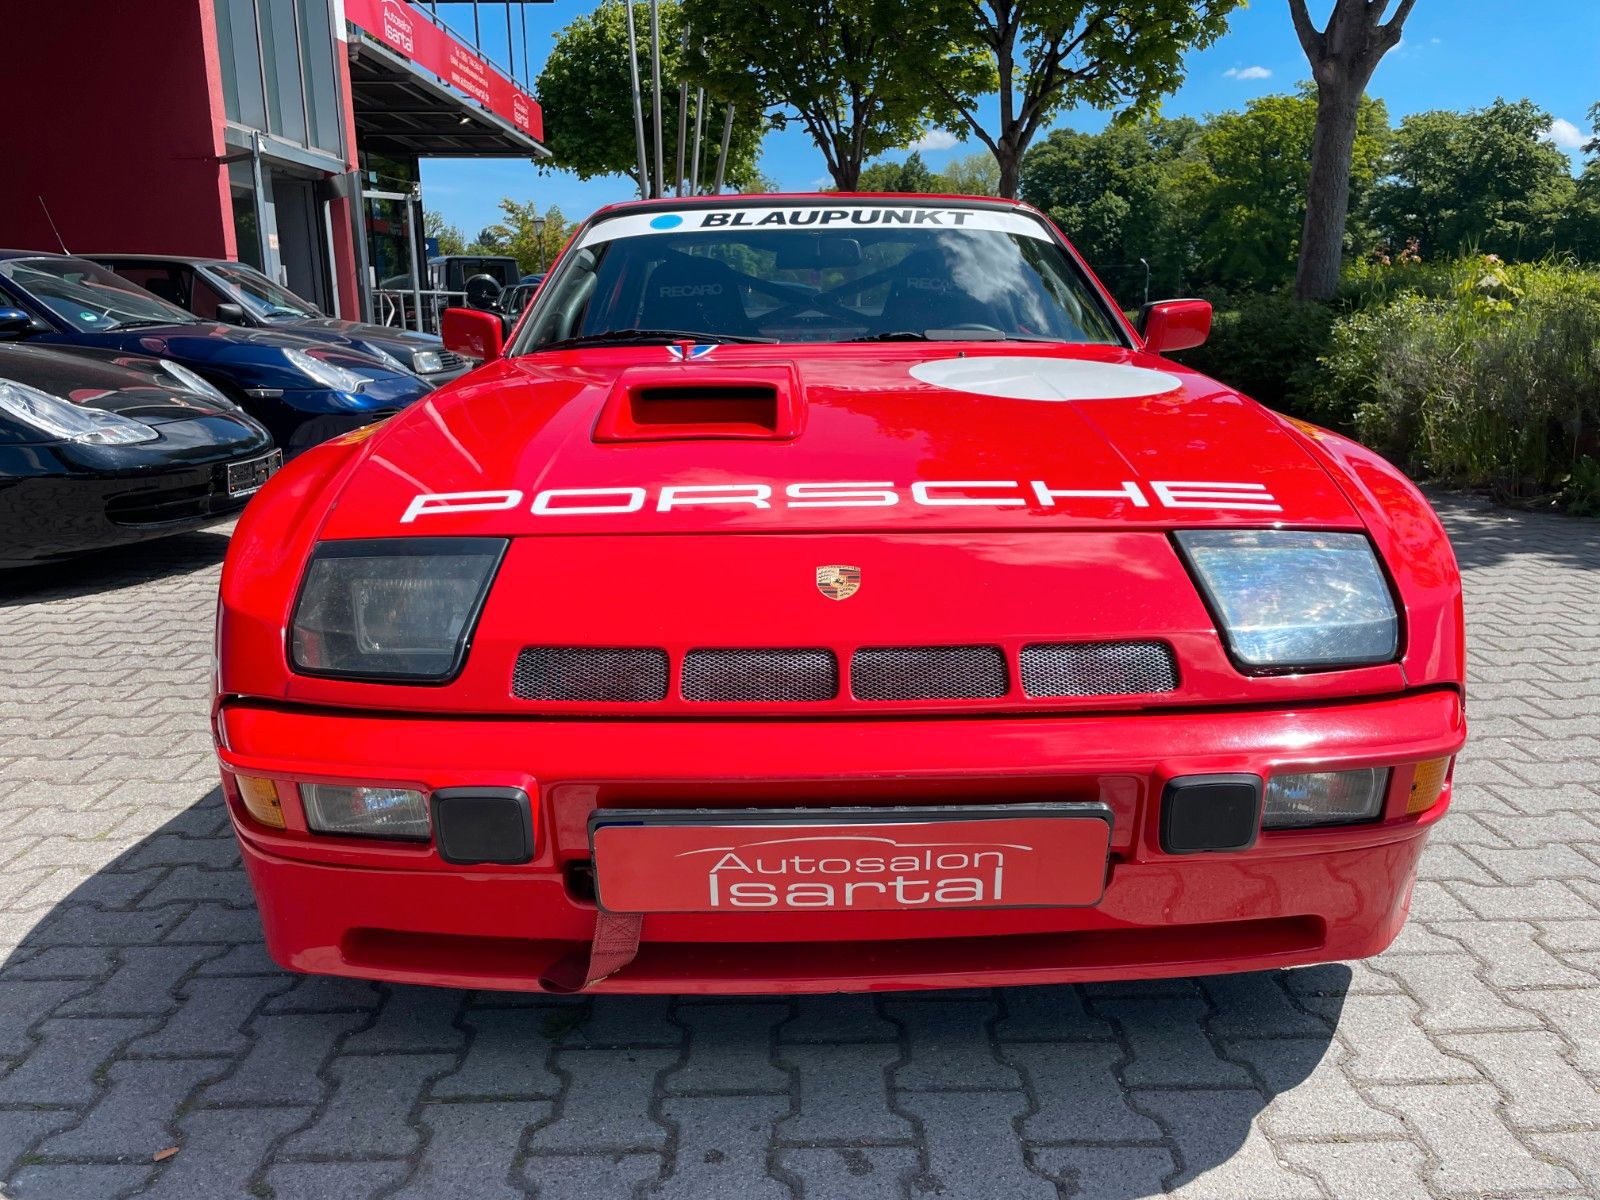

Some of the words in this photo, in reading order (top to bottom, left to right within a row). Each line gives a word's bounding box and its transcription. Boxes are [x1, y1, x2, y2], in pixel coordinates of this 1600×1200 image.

[384, 17, 414, 54] Isartal
[700, 210, 974, 228] BLAUPUNKT
[659, 283, 723, 298] RECARO
[400, 480, 1283, 523] PORSCHE
[709, 849, 1005, 874] Autosalon
[708, 867, 1004, 907] Isartal
